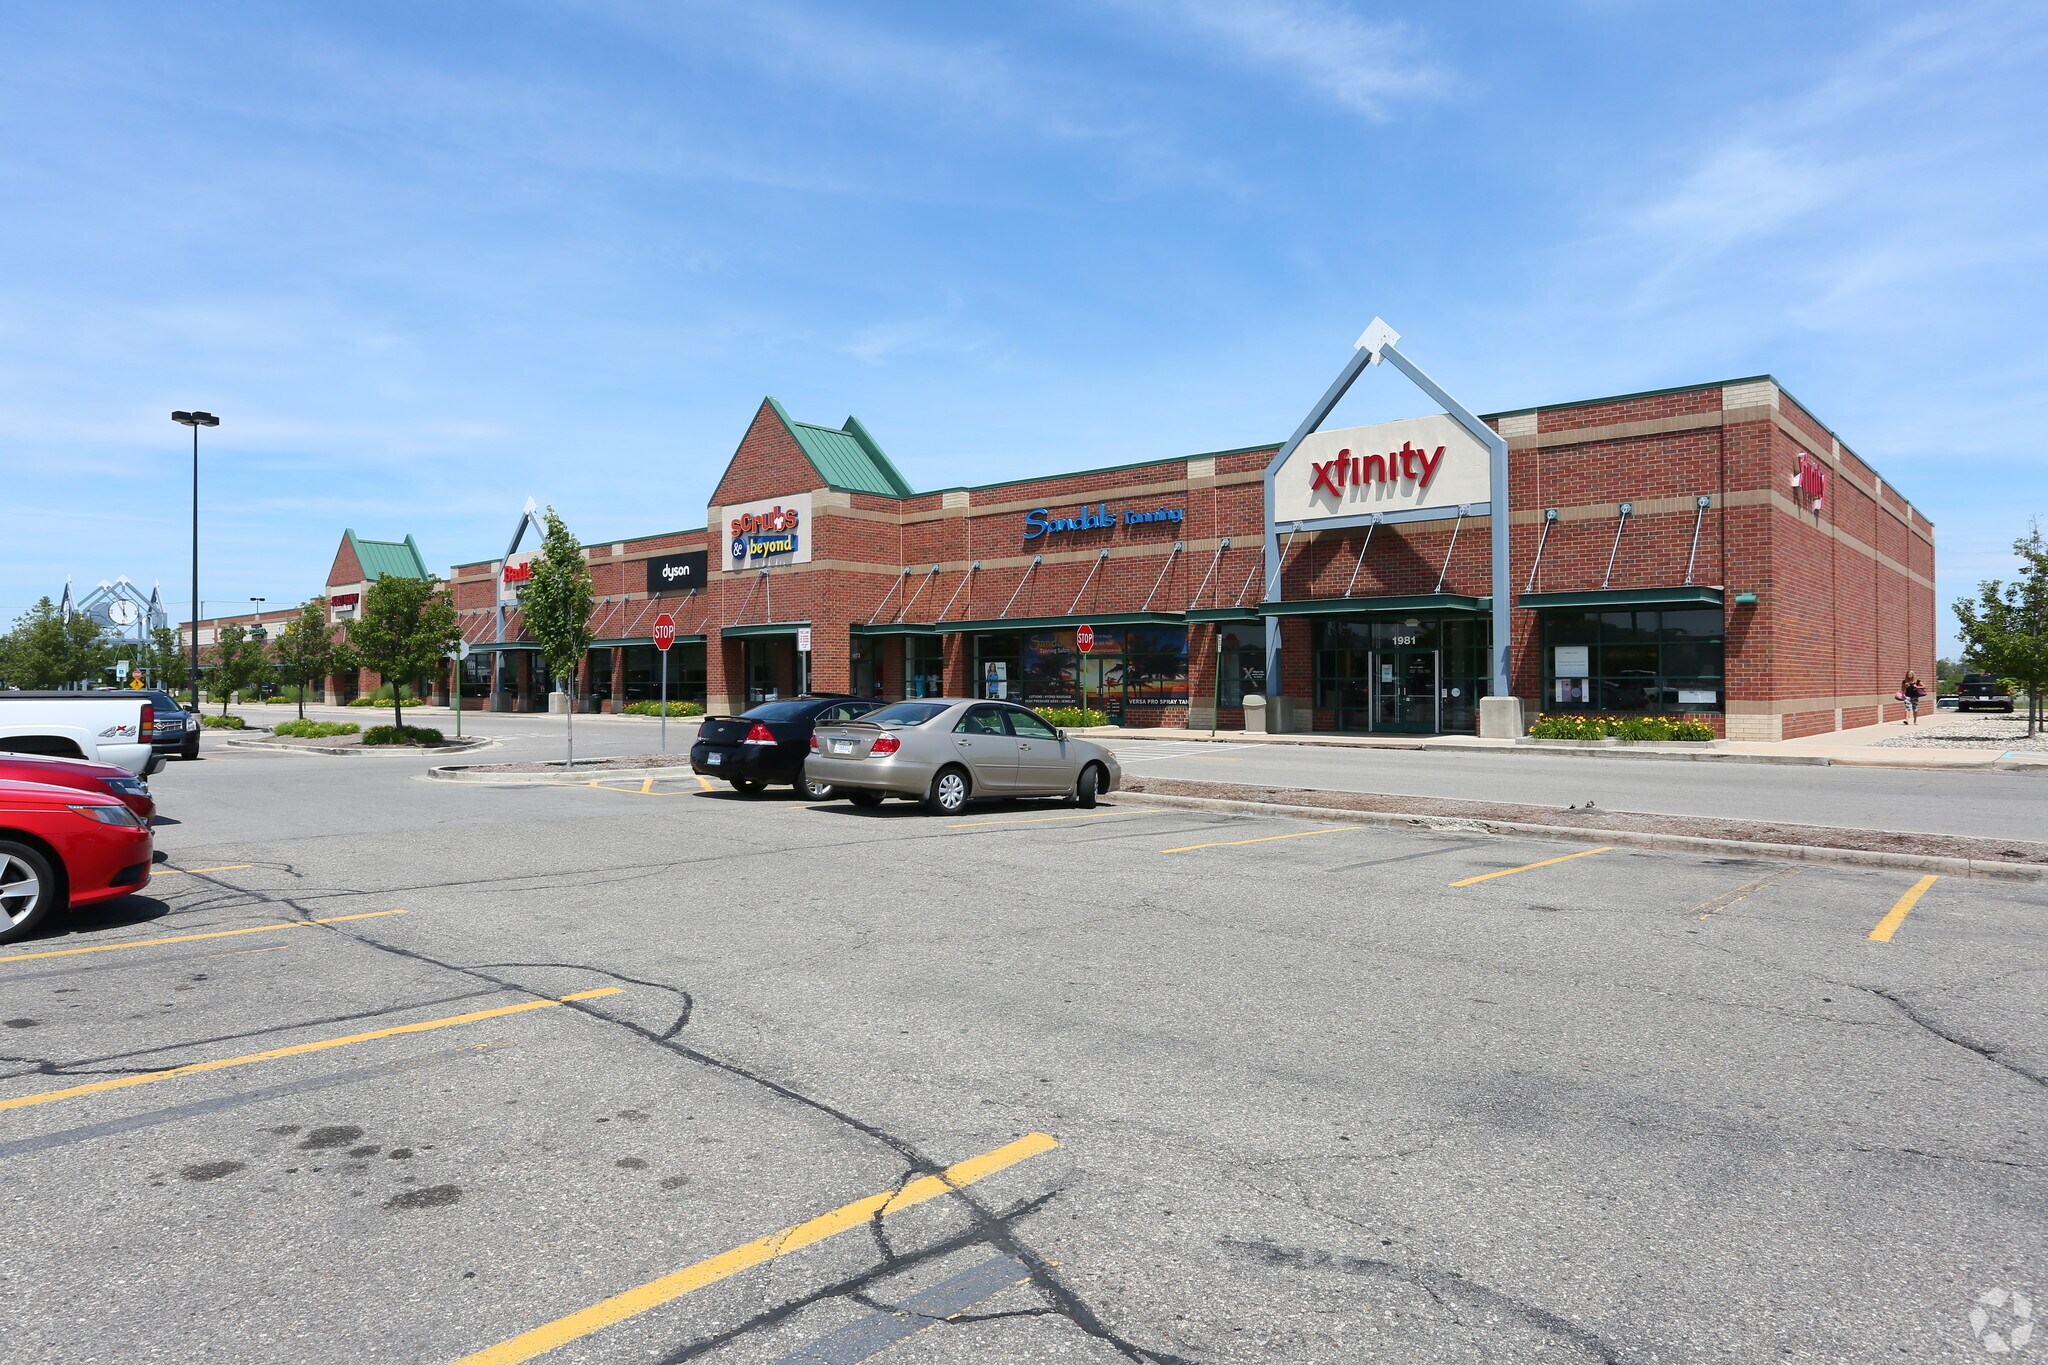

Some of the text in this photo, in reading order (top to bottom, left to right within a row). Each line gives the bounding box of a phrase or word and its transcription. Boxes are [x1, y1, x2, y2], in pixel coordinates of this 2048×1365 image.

[1311, 441, 1446, 497] xfinity
[1023, 504, 1183, 538] Sandals Tanning
[733, 535, 792, 558] & beyond
[662, 563, 690, 582] dyson
[655, 625, 674, 639] STOP
[1078, 633, 1093, 644] STOP
[1392, 635, 1416, 646] 1981
